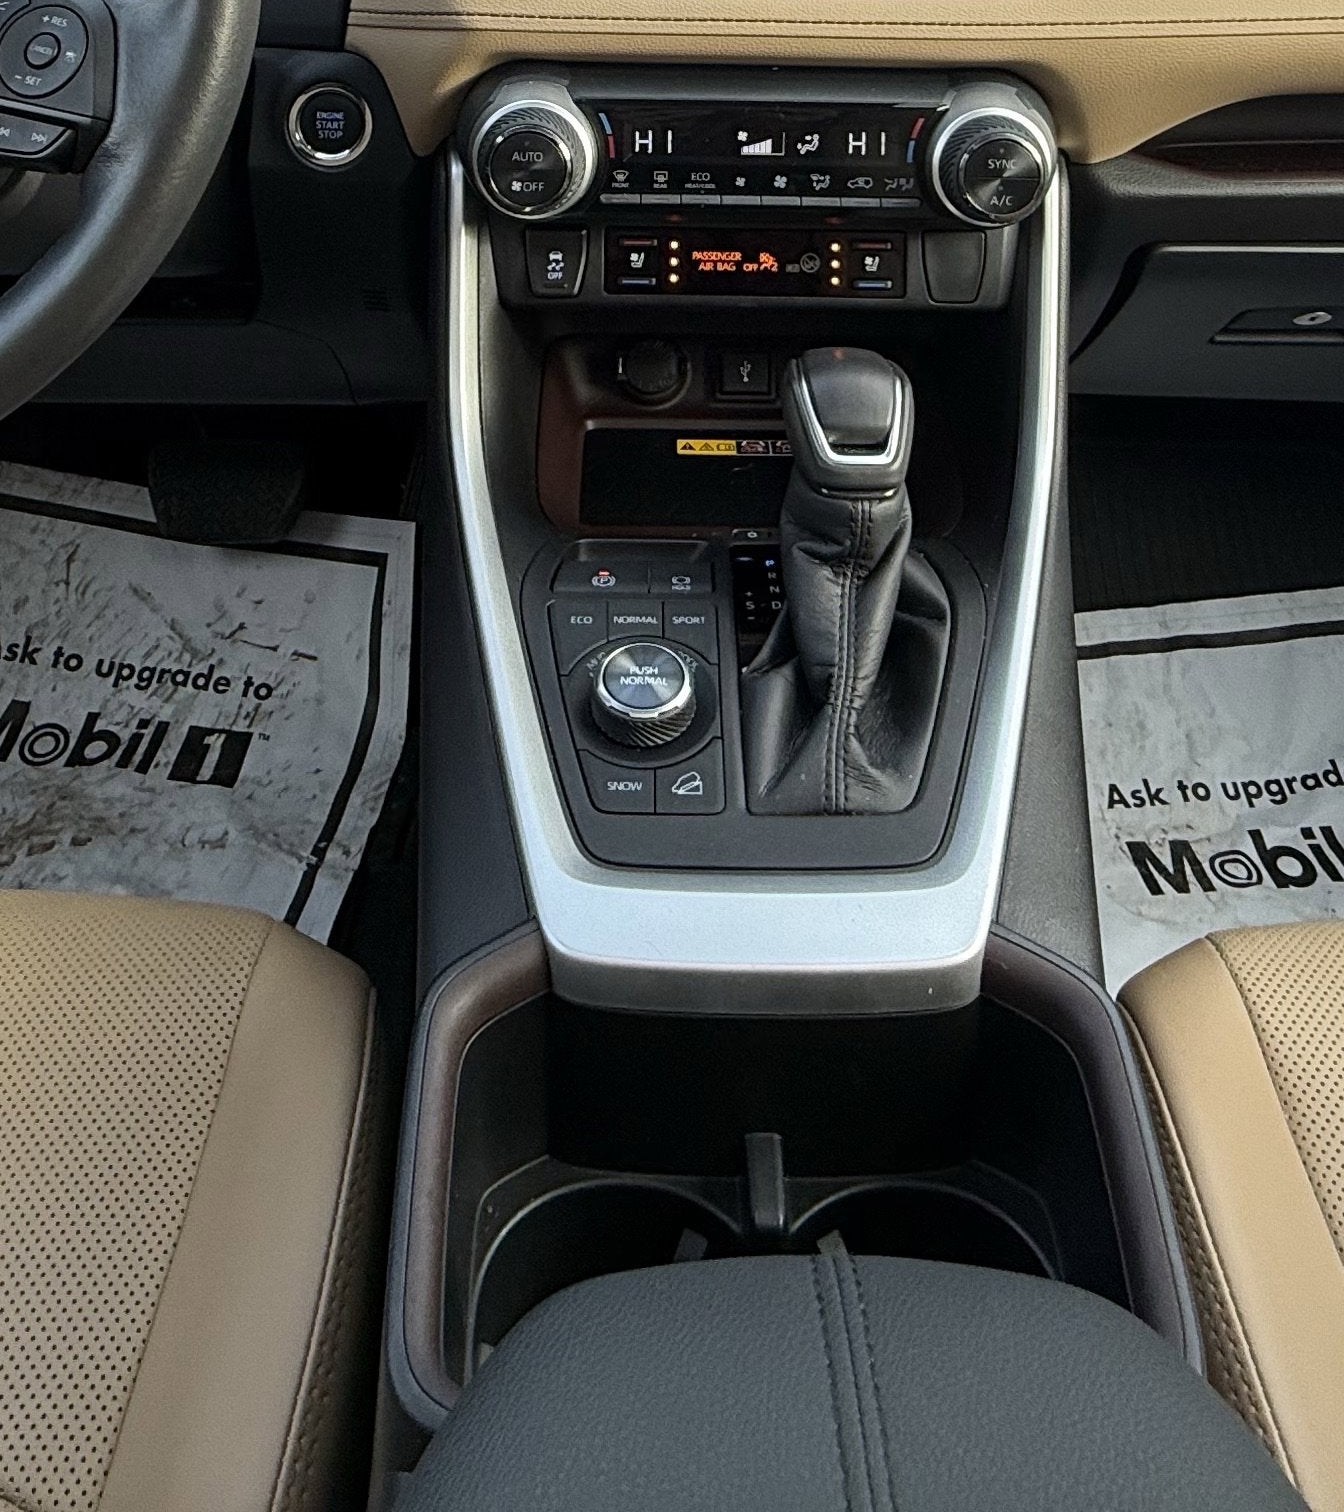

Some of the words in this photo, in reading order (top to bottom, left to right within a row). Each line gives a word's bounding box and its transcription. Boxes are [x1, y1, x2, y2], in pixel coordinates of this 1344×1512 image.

[316, 111, 345, 119] ENGINE
[316, 120, 346, 129] START
[318, 130, 344, 139] STOP
[511, 151, 544, 162] AUTO
[987, 158, 1017, 169] SYNC
[690, 172, 711, 181] ECO
[522, 181, 545, 192] OFF
[990, 196, 1013, 207] A/C
[691, 251, 742, 261] PASSENGER
[698, 262, 714, 271] AIR
[716, 262, 737, 271] BAG
[547, 271, 564, 280] OFF
[769, 586, 780, 594] N
[745, 601, 755, 610] S
[772, 600, 782, 610] D
[570, 615, 592, 624] ECO
[613, 615, 659, 624] NORMAL
[672, 615, 705, 625] SPORT
[51, 645, 84, 674] to
[93, 656, 233, 696] upgrade
[241, 674, 275, 704] to
[629, 665, 659, 675] PUSH
[619, 676, 669, 687] NORMAL
[607, 781, 642, 791] SNOW
[1106, 779, 1168, 811] Ask
[1176, 777, 1211, 804] to
